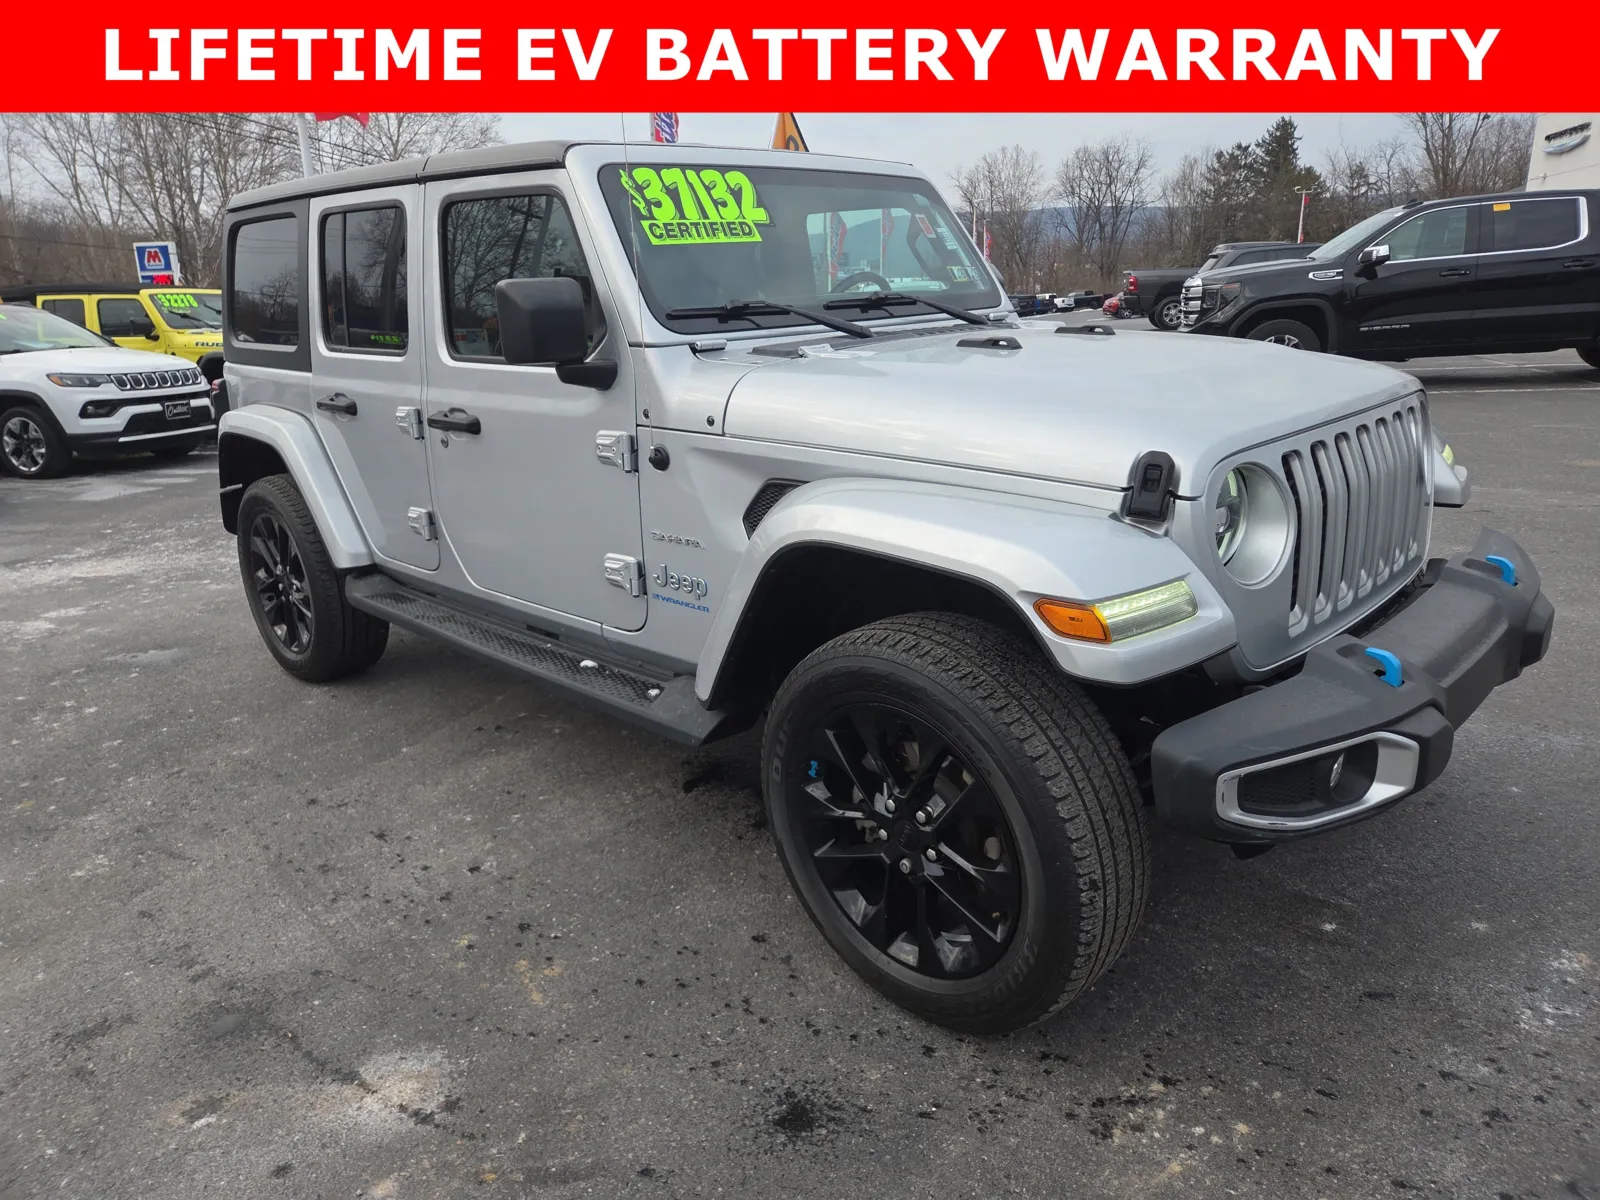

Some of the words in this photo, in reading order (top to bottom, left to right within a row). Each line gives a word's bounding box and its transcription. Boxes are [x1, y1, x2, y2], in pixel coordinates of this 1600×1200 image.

[619, 167, 769, 224] $37132
[648, 221, 755, 241] CERTIFIED
[650, 530, 705, 549] SAHARA
[652, 563, 708, 601] Jeep
[660, 595, 710, 613] WRANGLER
